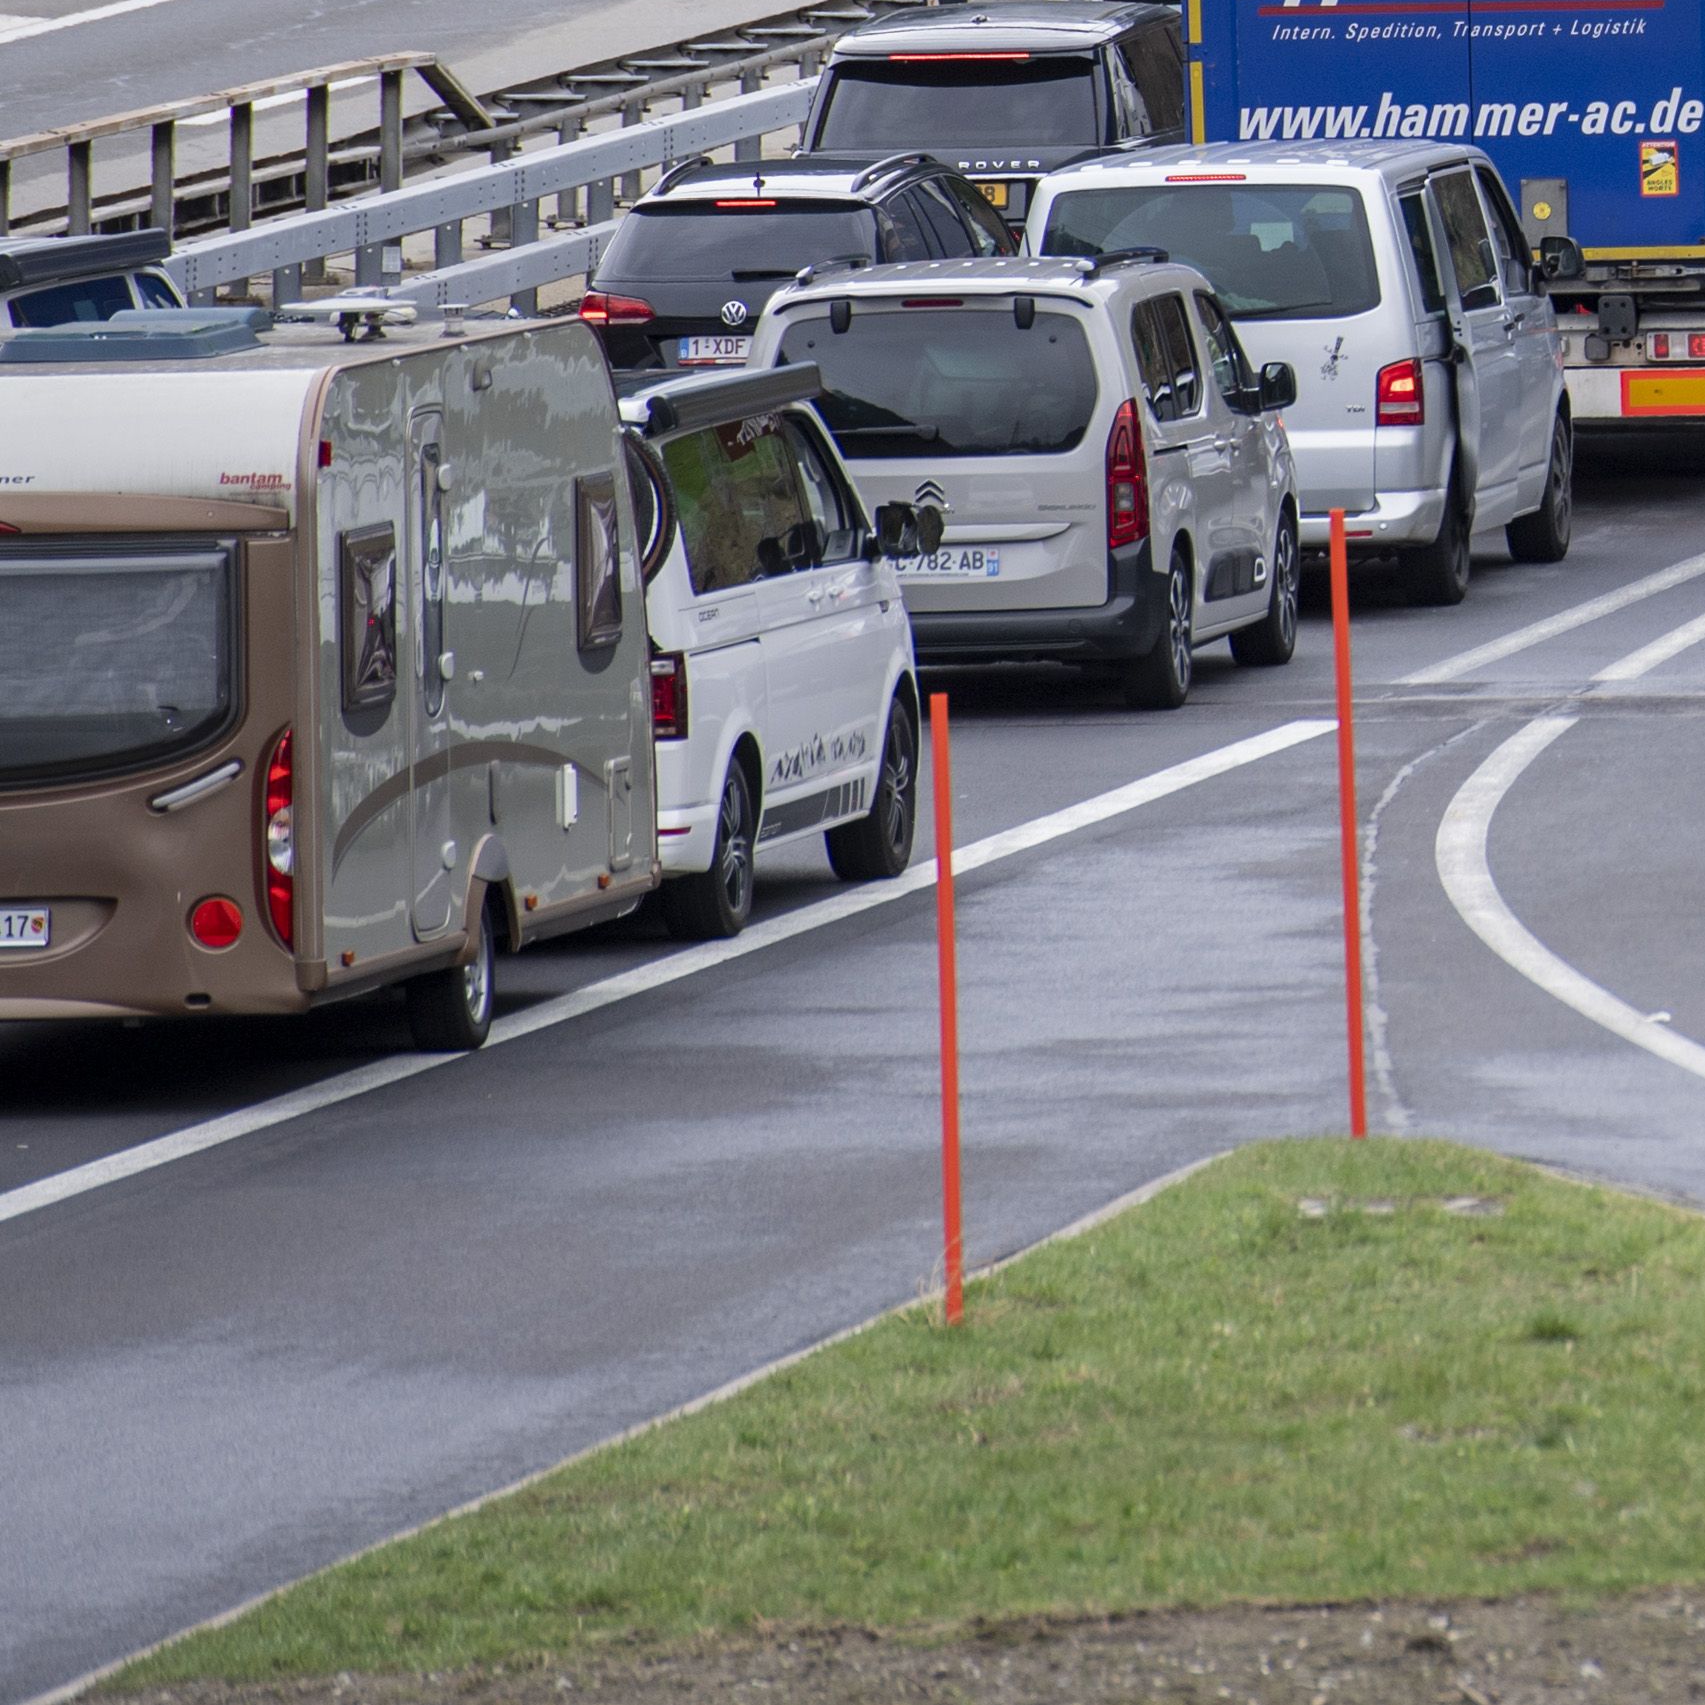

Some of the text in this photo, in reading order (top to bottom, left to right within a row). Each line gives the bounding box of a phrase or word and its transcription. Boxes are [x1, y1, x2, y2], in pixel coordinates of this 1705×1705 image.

[1272, 25, 1336, 40] Intern.
[1346, 23, 1443, 41] Spedition,
[1453, 21, 1546, 39] Transport
[1570, 19, 1647, 37] Logistik
[1239, 87, 1704, 140] www.hammer-ac.de
[958, 160, 1040, 169] ROVER
[219, 472, 282, 485] bantam
[250, 482, 292, 491] camping
